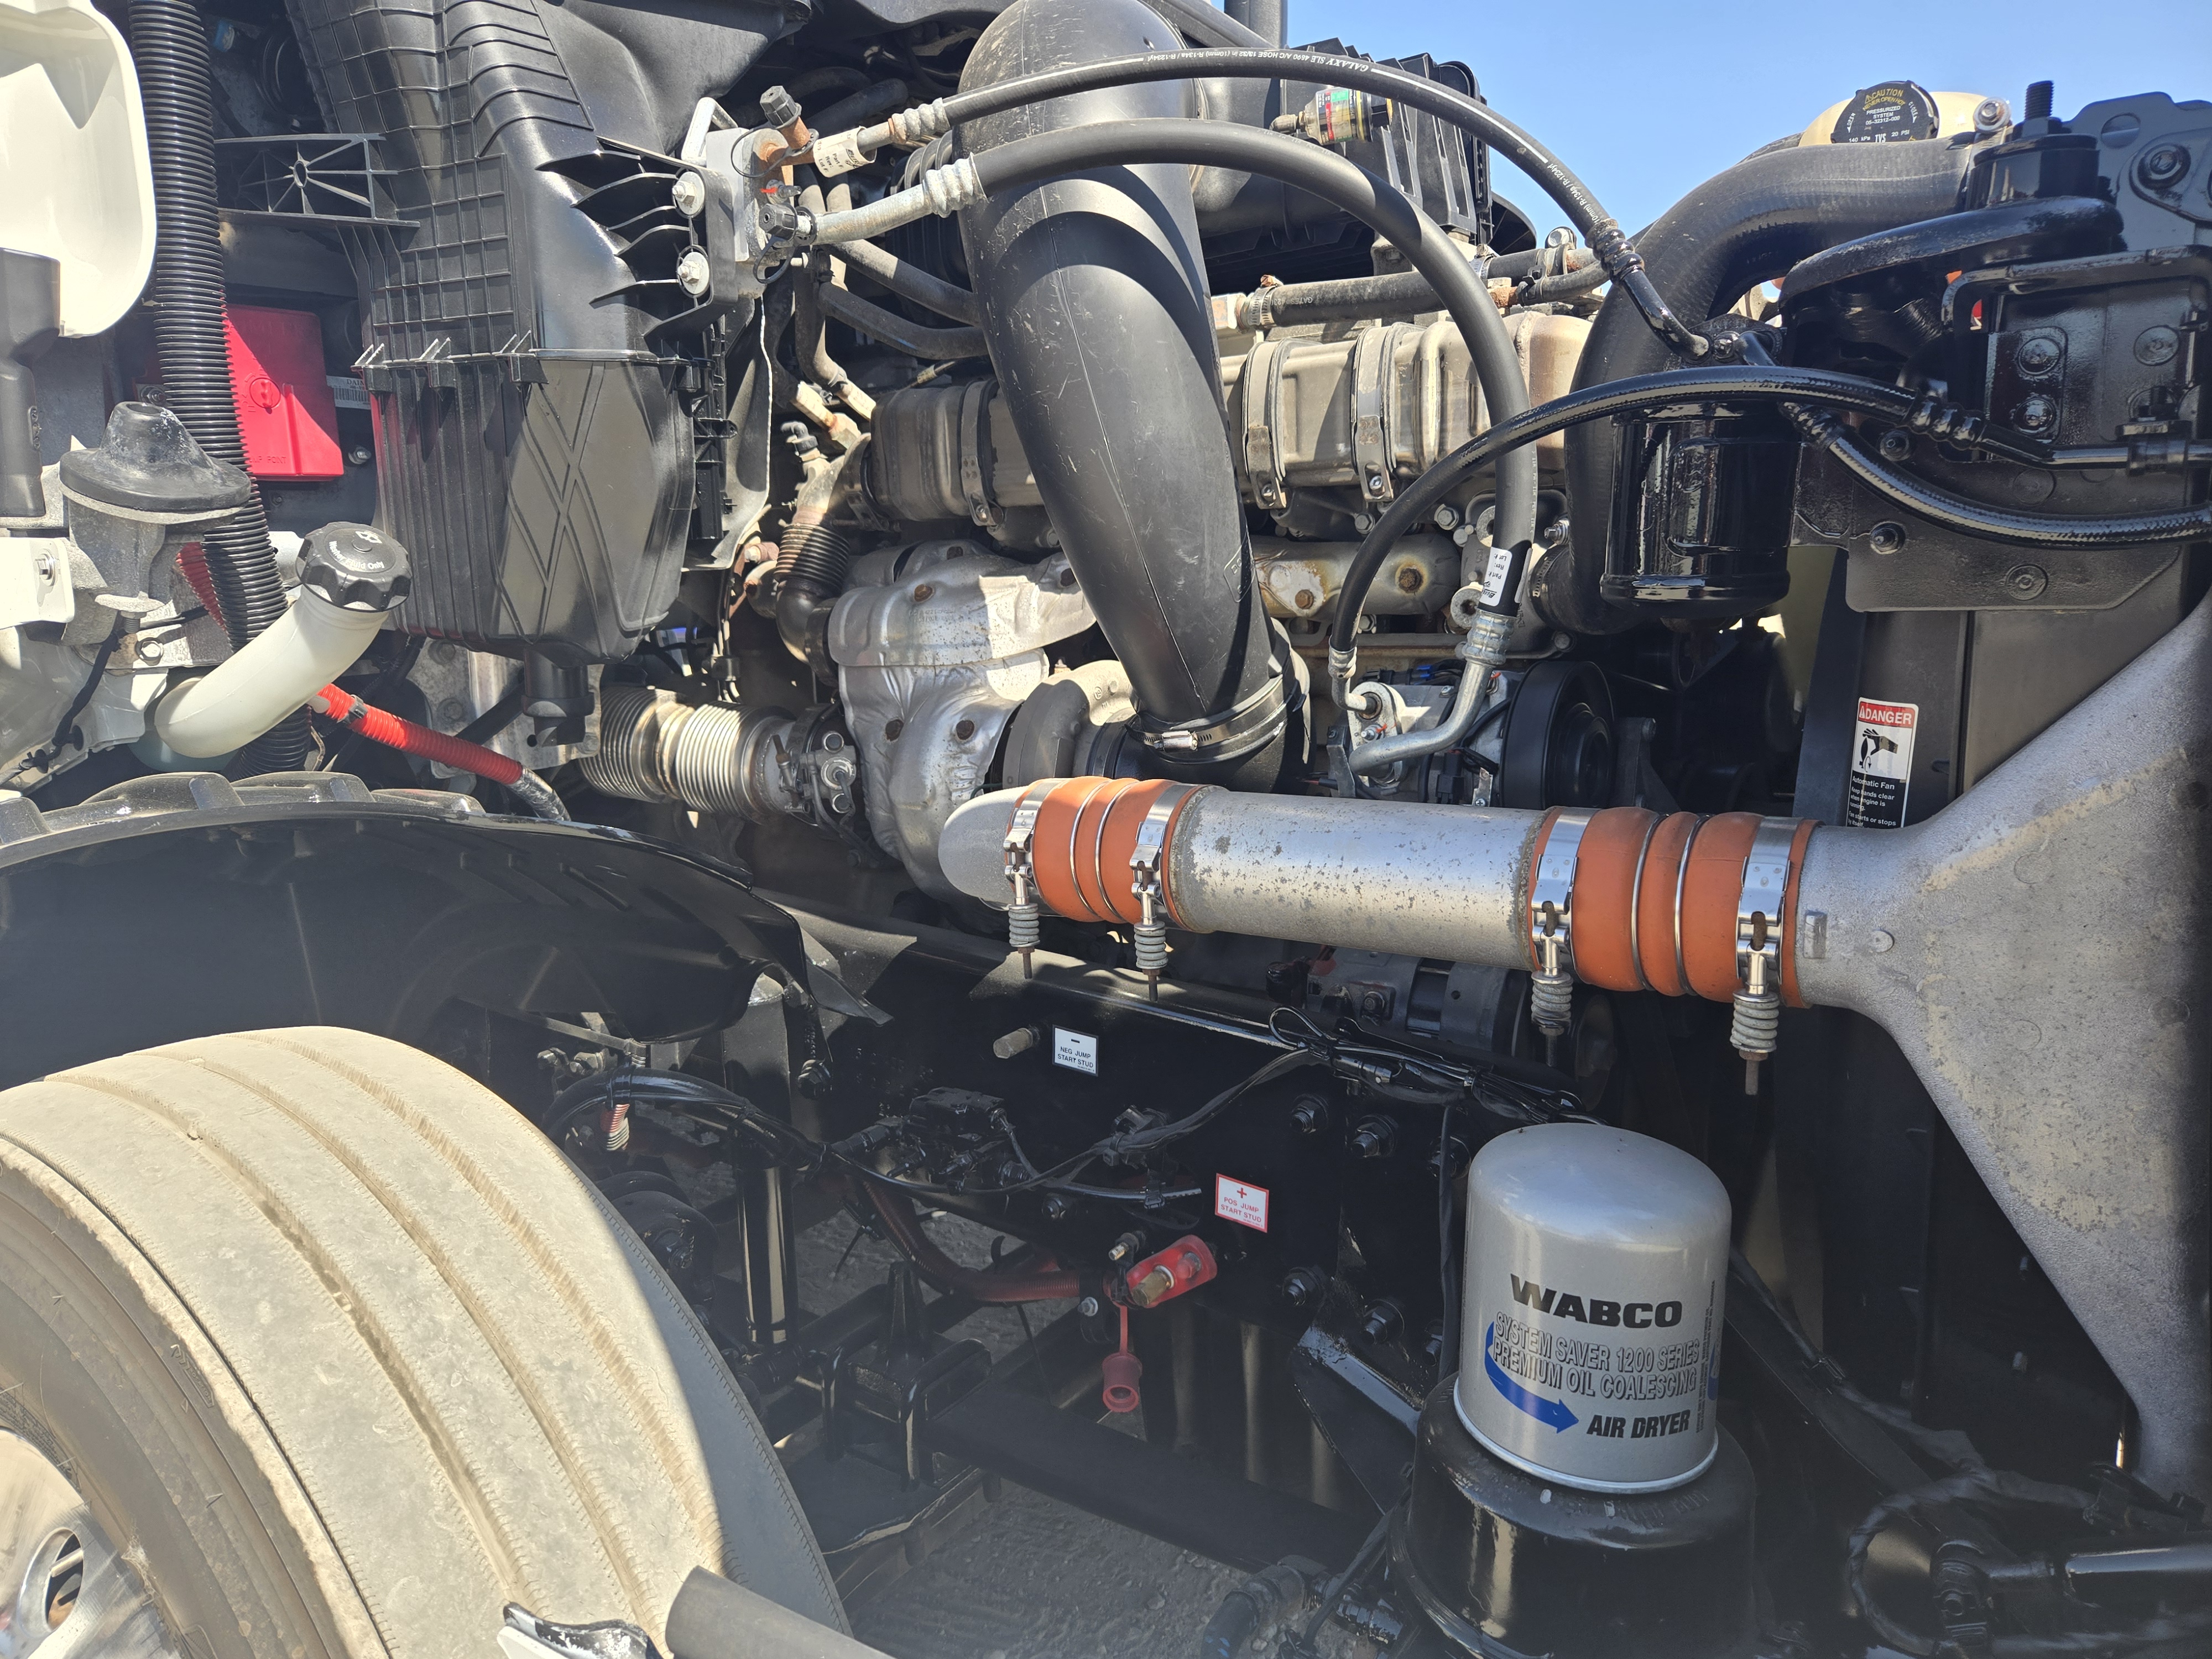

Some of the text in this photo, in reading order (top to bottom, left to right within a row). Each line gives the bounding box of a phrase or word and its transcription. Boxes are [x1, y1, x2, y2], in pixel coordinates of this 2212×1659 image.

[1147, 54, 1176, 62] R-1234yf
[1311, 55, 1326, 64] SLE
[1326, 58, 1369, 72] GALAXY
[1871, 88, 1903, 98] CAUTION
[1863, 100, 1880, 111] NEVER
[1866, 105, 1901, 115] PRESSURIZED
[1847, 112, 1856, 126] OPEN
[1875, 133, 1887, 143] TVS
[1547, 164, 1570, 186] R-1234yf
[1570, 186, 1587, 206] R-134a
[328, 541, 385, 570] Washer Fluid Only
[1866, 708, 1912, 726] DANGER
[1853, 775, 1879, 787] Automatic
[1851, 786, 1860, 795] Keep
[1058, 1054, 1094, 1068] START STUD
[1075, 1051, 1091, 1059] JUMP
[1224, 1197, 1259, 1213] POS JUMP
[1221, 1204, 1242, 1215] START
[1244, 1212, 1262, 1223] STUD
[1510, 1273, 1682, 1329] WABCO
[1495, 1311, 1700, 1374] SYSTEM SAVER 1200 SERIES
[1493, 1335, 1697, 1401] PREMIUM OIL COALESCING
[1587, 1409, 1691, 1439] AIR DRYER
